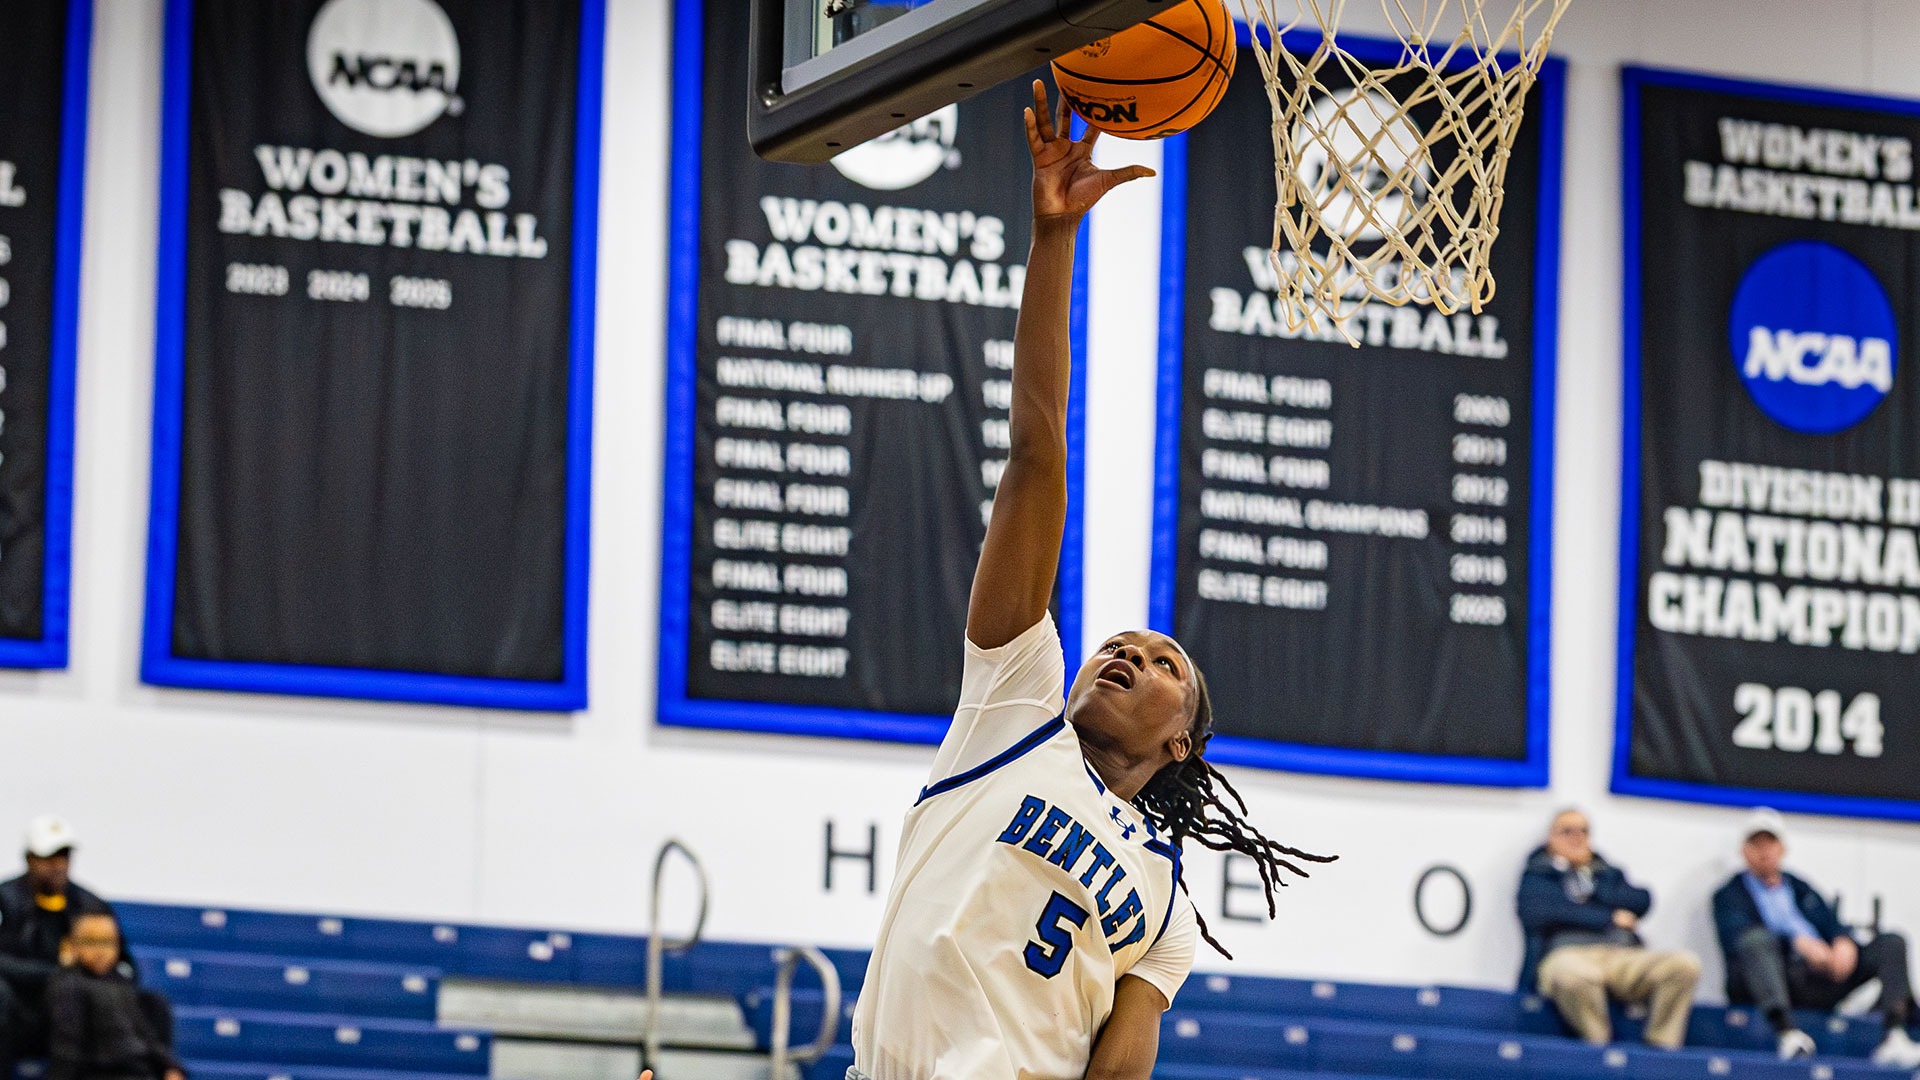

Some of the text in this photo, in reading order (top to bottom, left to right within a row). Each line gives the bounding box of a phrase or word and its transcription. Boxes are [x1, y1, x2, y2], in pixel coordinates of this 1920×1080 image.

[329, 53, 448, 96] NCAA
[1718, 117, 1913, 182] WOMEN'S
[254, 144, 511, 209] WOMEN'S
[1683, 160, 1920, 230] BASKETBAL
[218, 188, 547, 259] BASKETBALL
[760, 196, 1005, 261] WOMEN'S
[307, 269, 369, 302] 2024
[716, 316, 786, 350] FINAL
[787, 322, 852, 355] FOUR
[1209, 287, 1508, 358] BASKETBALL
[717, 357, 825, 394] NATIONAL
[1744, 326, 1893, 394] NCAA
[1204, 368, 1269, 404] FINAL
[1270, 375, 1332, 410] FOUR
[715, 396, 785, 431] FINAL
[787, 402, 851, 436] FOUR
[1203, 408, 1266, 443] ELITE
[1267, 415, 1333, 449] EIGHT
[715, 437, 850, 477] FINAL FOUR
[1202, 448, 1268, 484] FINAL
[1269, 455, 1331, 490] FOUR
[713, 477, 849, 517] FINAL FOUR
[1699, 459, 1884, 522] DIVISION
[1201, 488, 1304, 528] NATIONAL
[1304, 499, 1429, 540] CHAMPIONS
[712, 518, 850, 557] ELITE EIGHT
[1200, 528, 1266, 565] FINAL
[1267, 536, 1328, 570] FOUR
[1662, 505, 1920, 589] NATIONA
[712, 558, 848, 597] FINAL FOUR
[1198, 568, 1262, 604] ELITE
[1262, 576, 1328, 611] EIGHT
[711, 599, 850, 638] ELITE EIGHT
[710, 639, 849, 678] ELITE EIGHT
[1731, 682, 1884, 758] 2014
[822, 818, 877, 893] H
[1413, 863, 1473, 937] O
[995, 794, 1146, 955] BENTLEY
[1022, 890, 1091, 980] 5
